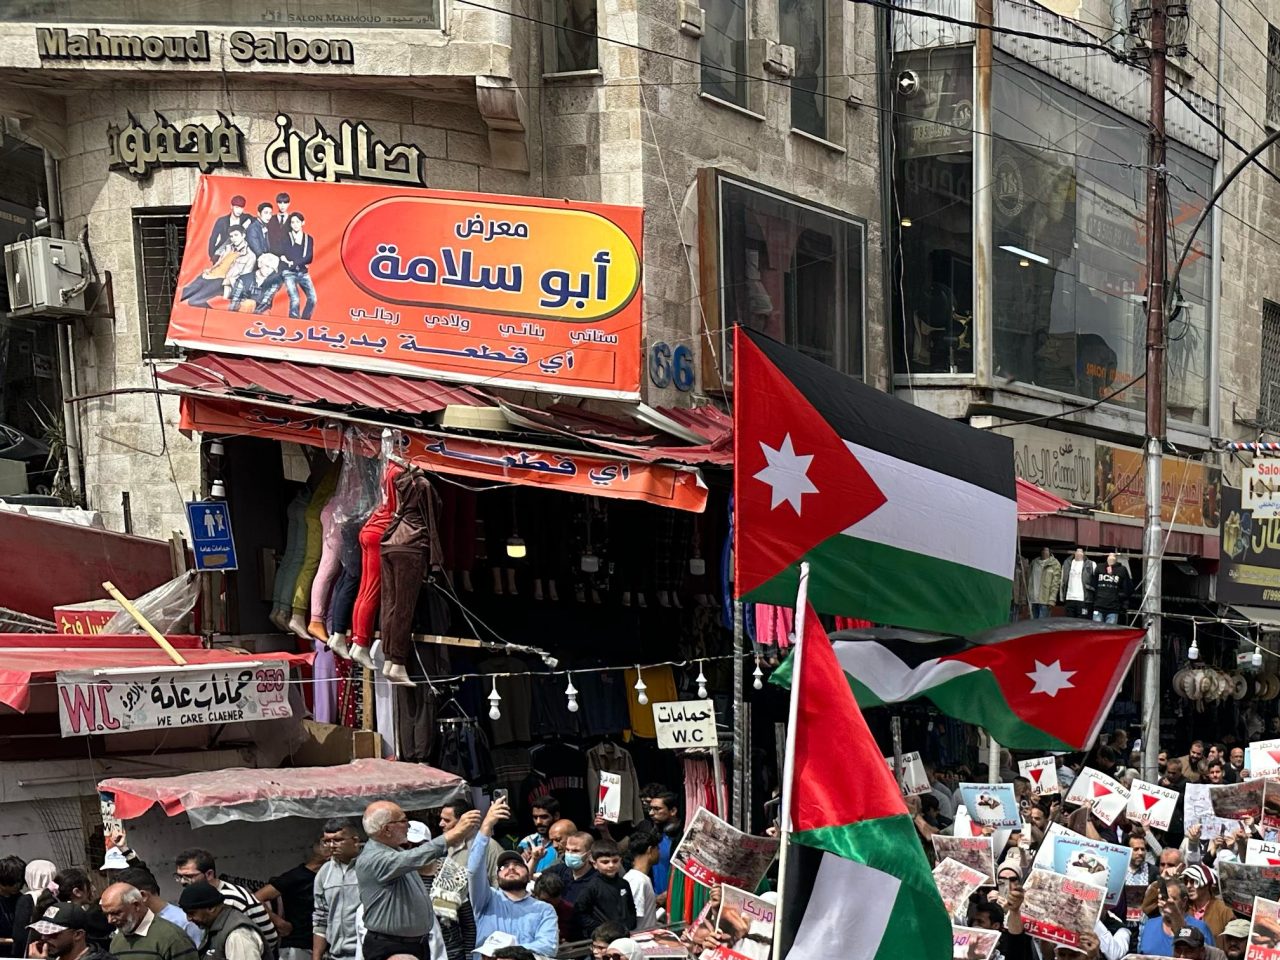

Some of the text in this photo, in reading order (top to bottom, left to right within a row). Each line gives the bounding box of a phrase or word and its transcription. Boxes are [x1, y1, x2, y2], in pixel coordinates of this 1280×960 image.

[36, 28, 354, 65] Mahmoud Saloon
[107, 108, 426, 186] صالون محمود
[455, 213, 529, 241] معرض
[370, 245, 611, 308] أبو سلامة
[349, 305, 401, 325] رجالي
[424, 313, 471, 332] ولادي
[499, 321, 545, 339] بناتي
[243, 320, 575, 374] أي قطعة بدينارين
[649, 341, 696, 391] 66
[425, 439, 630, 493] أي قطعة
[151, 676, 191, 709] عامة
[194, 670, 253, 711] حمامات
[256, 669, 285, 693] 250
[157, 715, 172, 727] WE
[261, 706, 290, 718] FILS
[658, 706, 711, 723] حمامات
[672, 730, 704, 743] W.C
[742, 899, 775, 923] مريكا
[1248, 949, 1266, 960] غزة
